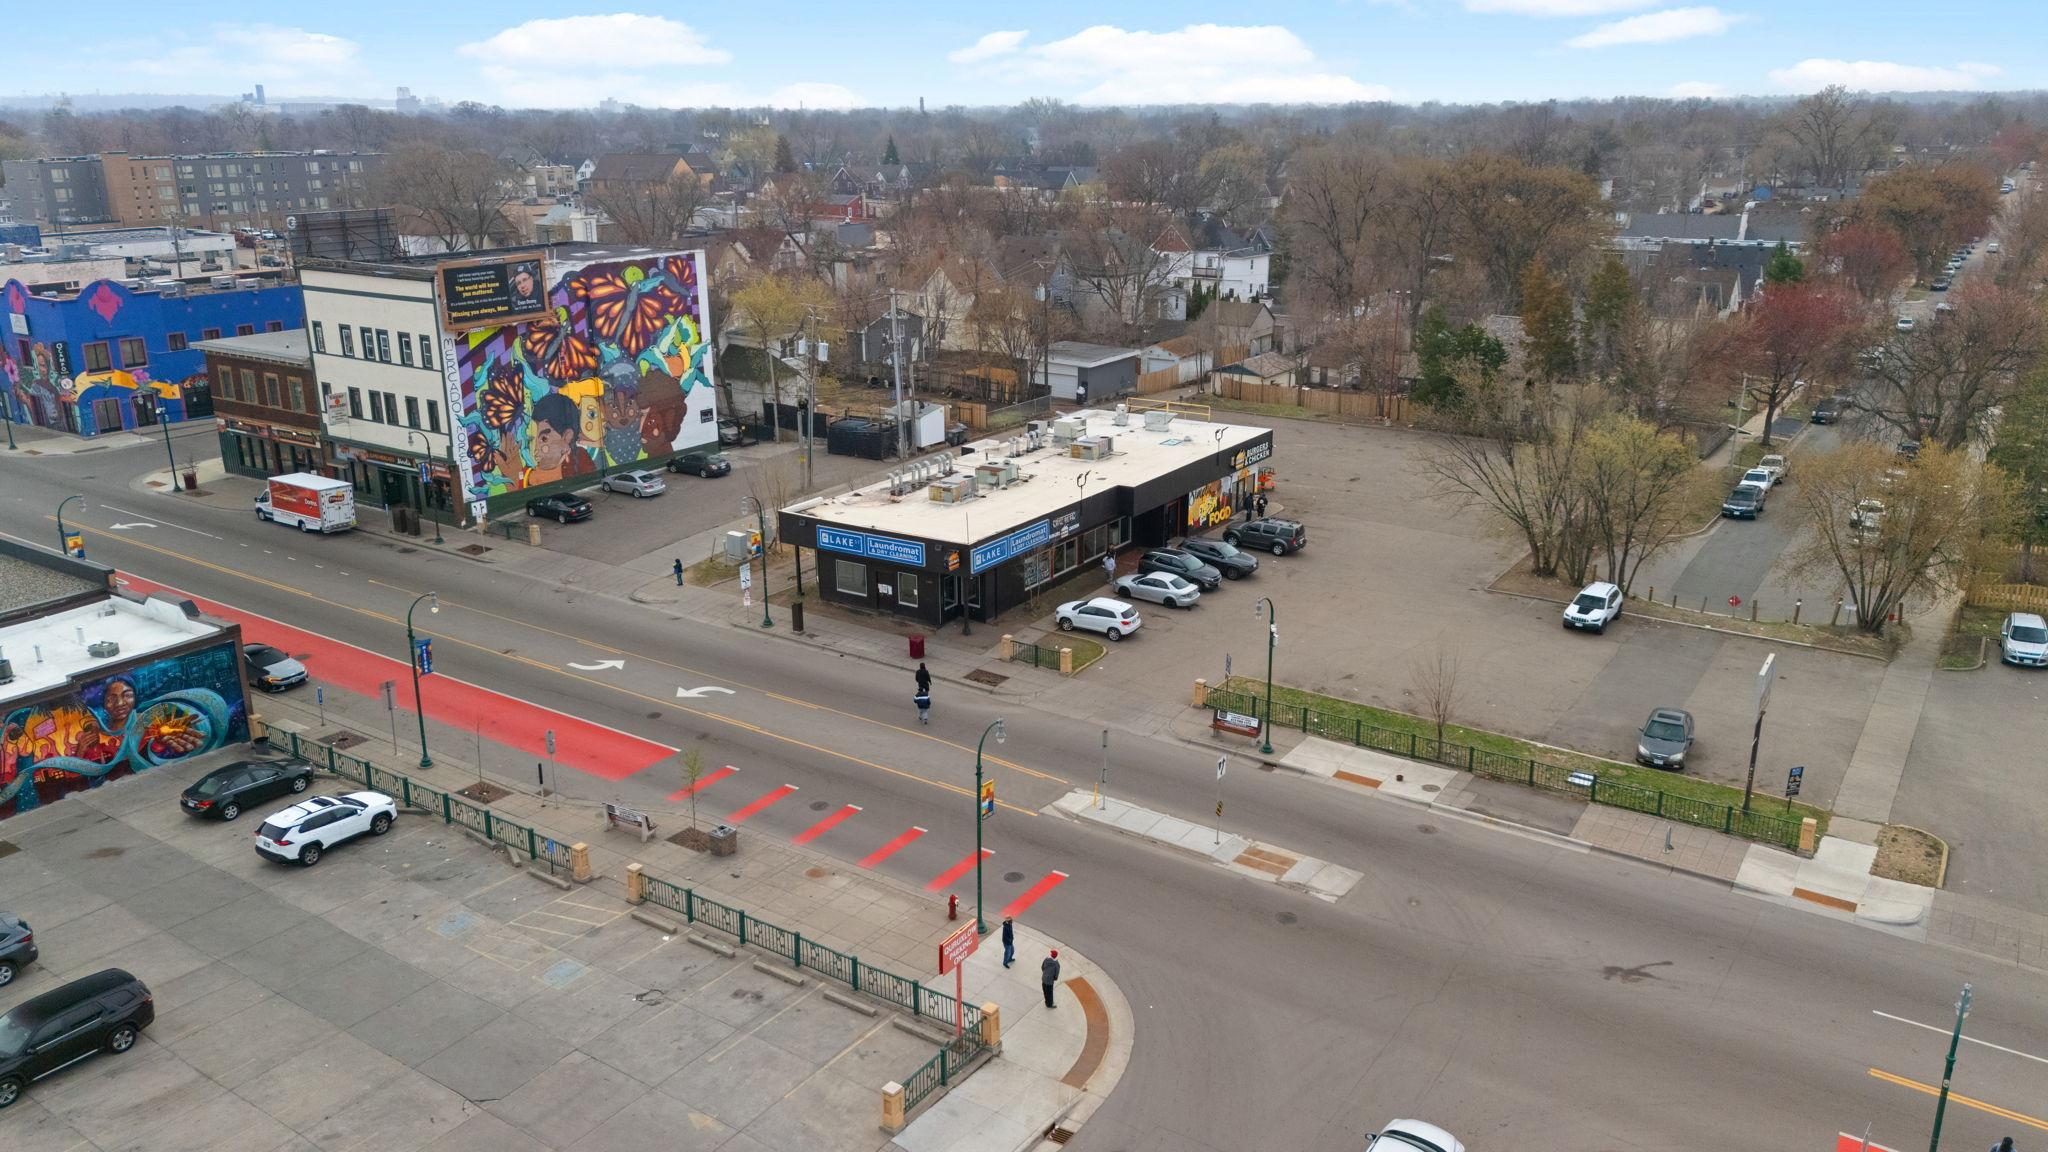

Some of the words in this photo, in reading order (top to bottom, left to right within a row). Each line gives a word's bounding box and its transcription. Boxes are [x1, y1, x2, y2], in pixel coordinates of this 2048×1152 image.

[444, 337, 462, 415] MERCADO
[456, 425, 473, 489] MORELIA
[1247, 442, 1269, 455] BURGERS
[1249, 450, 1270, 464] CHICKEN
[1209, 506, 1232, 526] FOOD
[830, 536, 854, 547] LAKE
[1012, 528, 1046, 545] Laundromat
[870, 539, 919, 556] Laundromat
[982, 548, 1000, 561] LAKE
[890, 551, 918, 561] CLEANING
[949, 937, 973, 960] PARKING
[954, 950, 968, 965] ONLY
